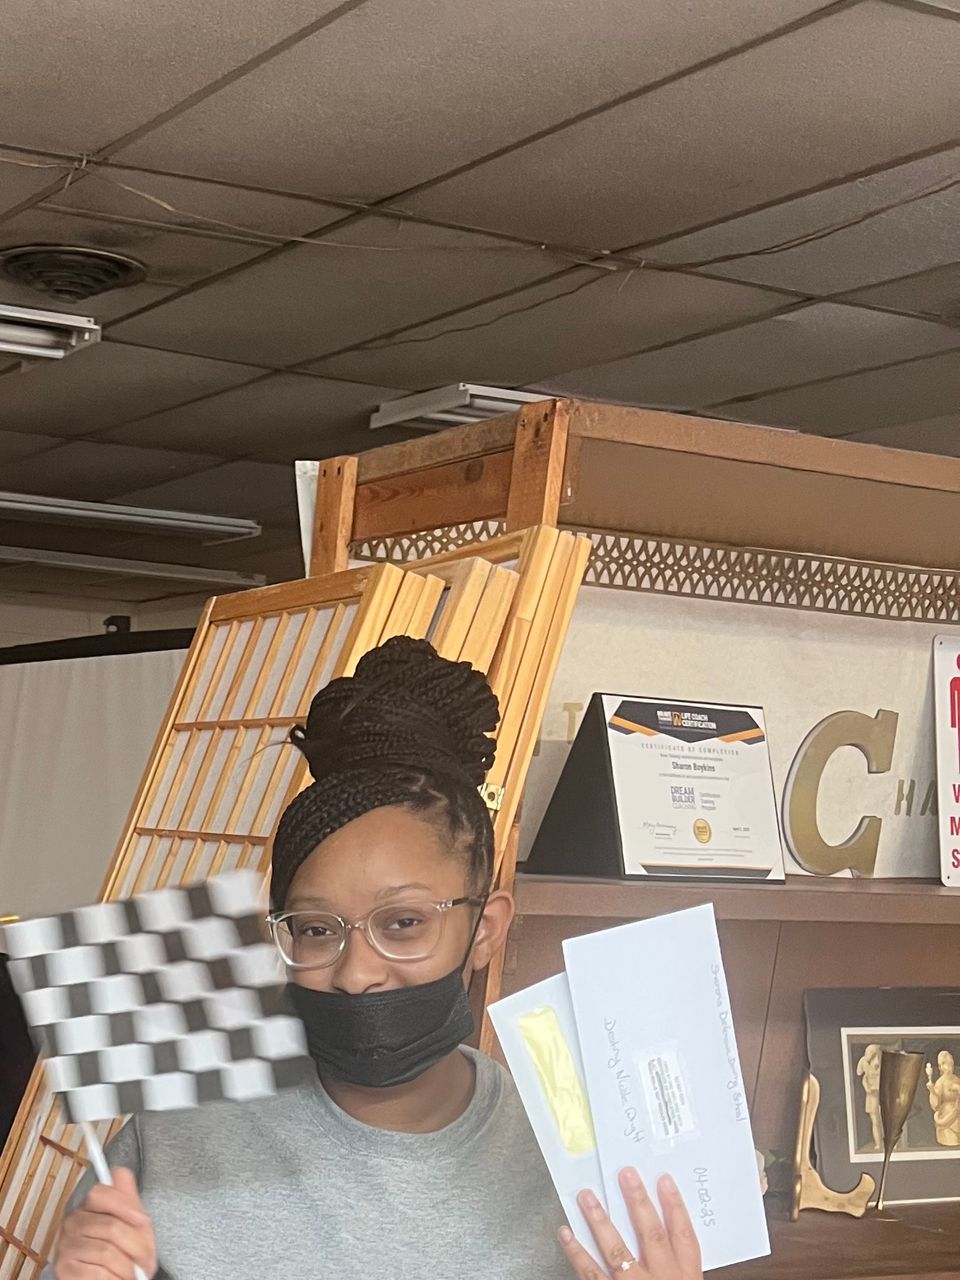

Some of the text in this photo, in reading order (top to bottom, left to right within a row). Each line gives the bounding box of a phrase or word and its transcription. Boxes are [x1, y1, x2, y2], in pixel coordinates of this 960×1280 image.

[641, 743, 684, 752] CERTIFICATE
[699, 747, 739, 756] COMPLETION
[672, 761, 715, 773] Sharon Boykins
[670, 786, 695, 795] DREAM
[782, 708, 899, 879] C
[672, 795, 695, 804] BUILDER
